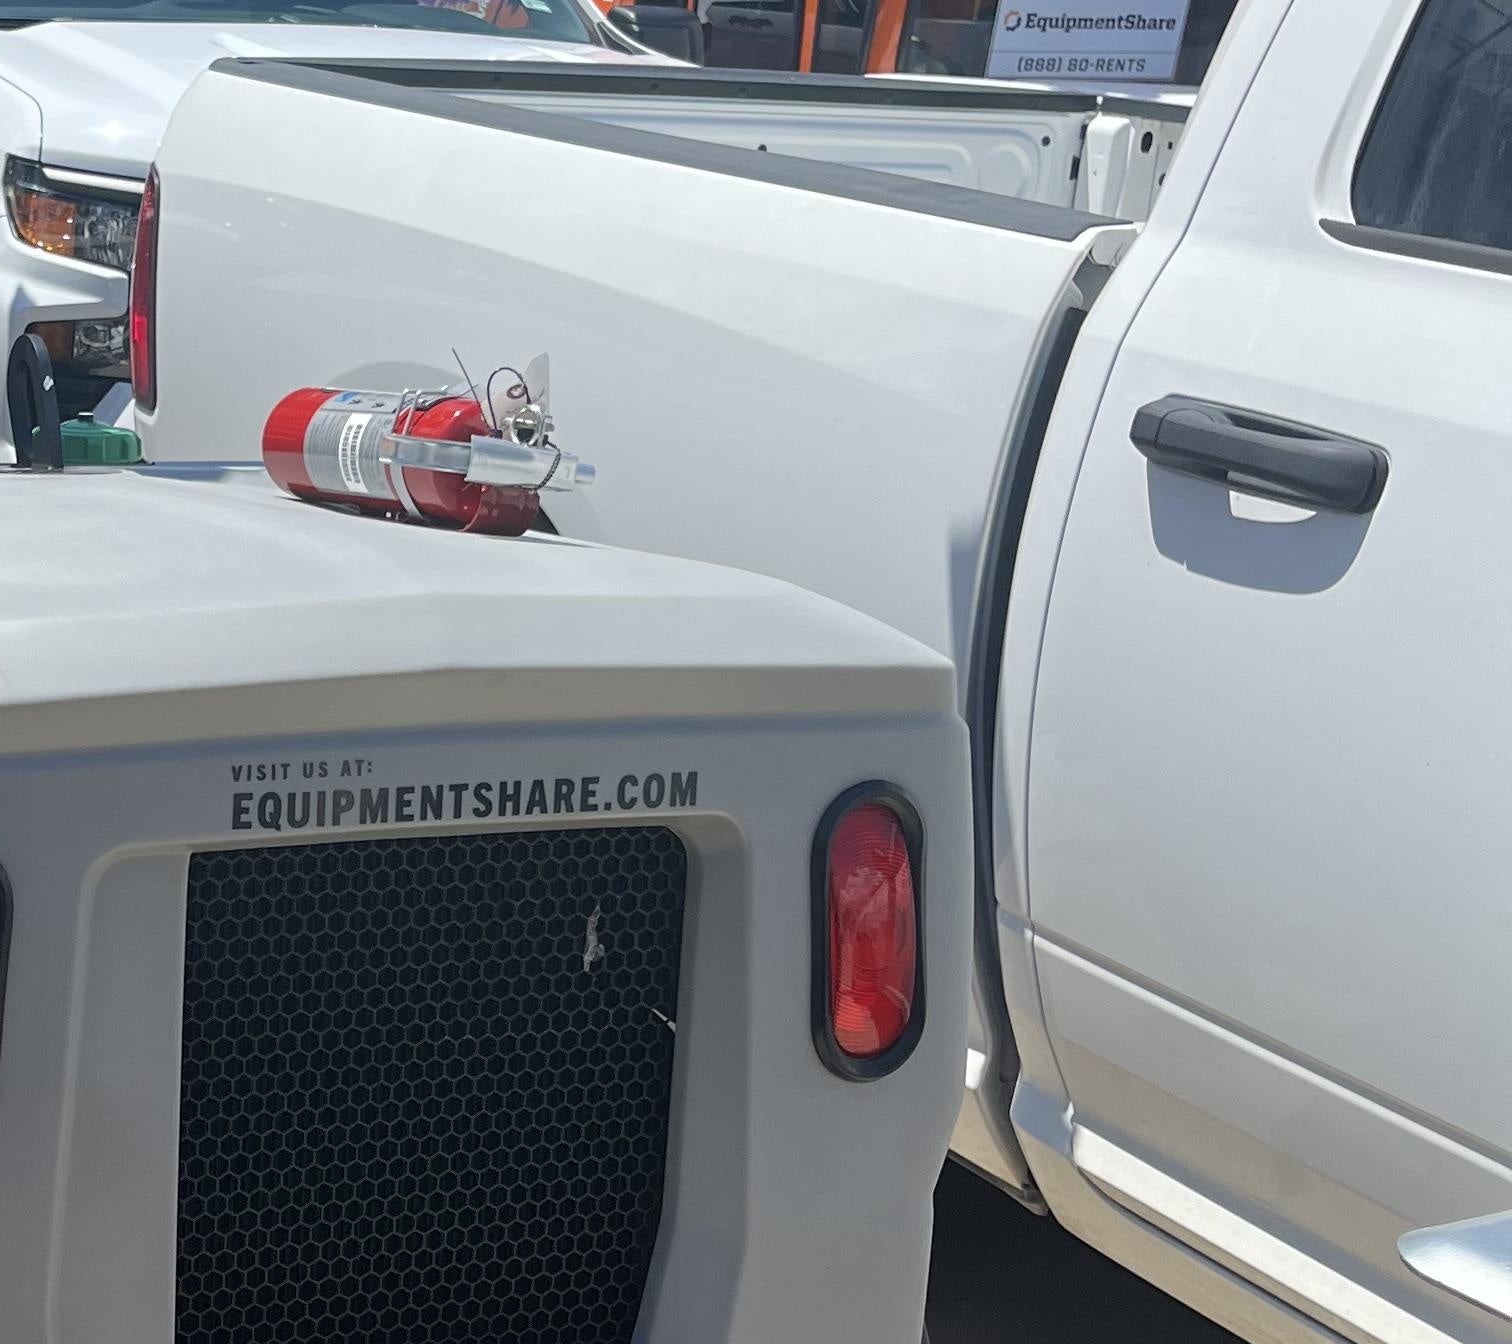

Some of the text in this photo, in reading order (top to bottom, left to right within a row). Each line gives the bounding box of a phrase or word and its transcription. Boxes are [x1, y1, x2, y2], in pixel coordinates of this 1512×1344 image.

[1025, 13, 1176, 33] EquipmentShare
[1017, 57, 1146, 73] (888) 80-RENTS
[231, 759, 373, 783] VISIT US AT:
[231, 771, 699, 832] EQUIPMENTSHARE.COM
